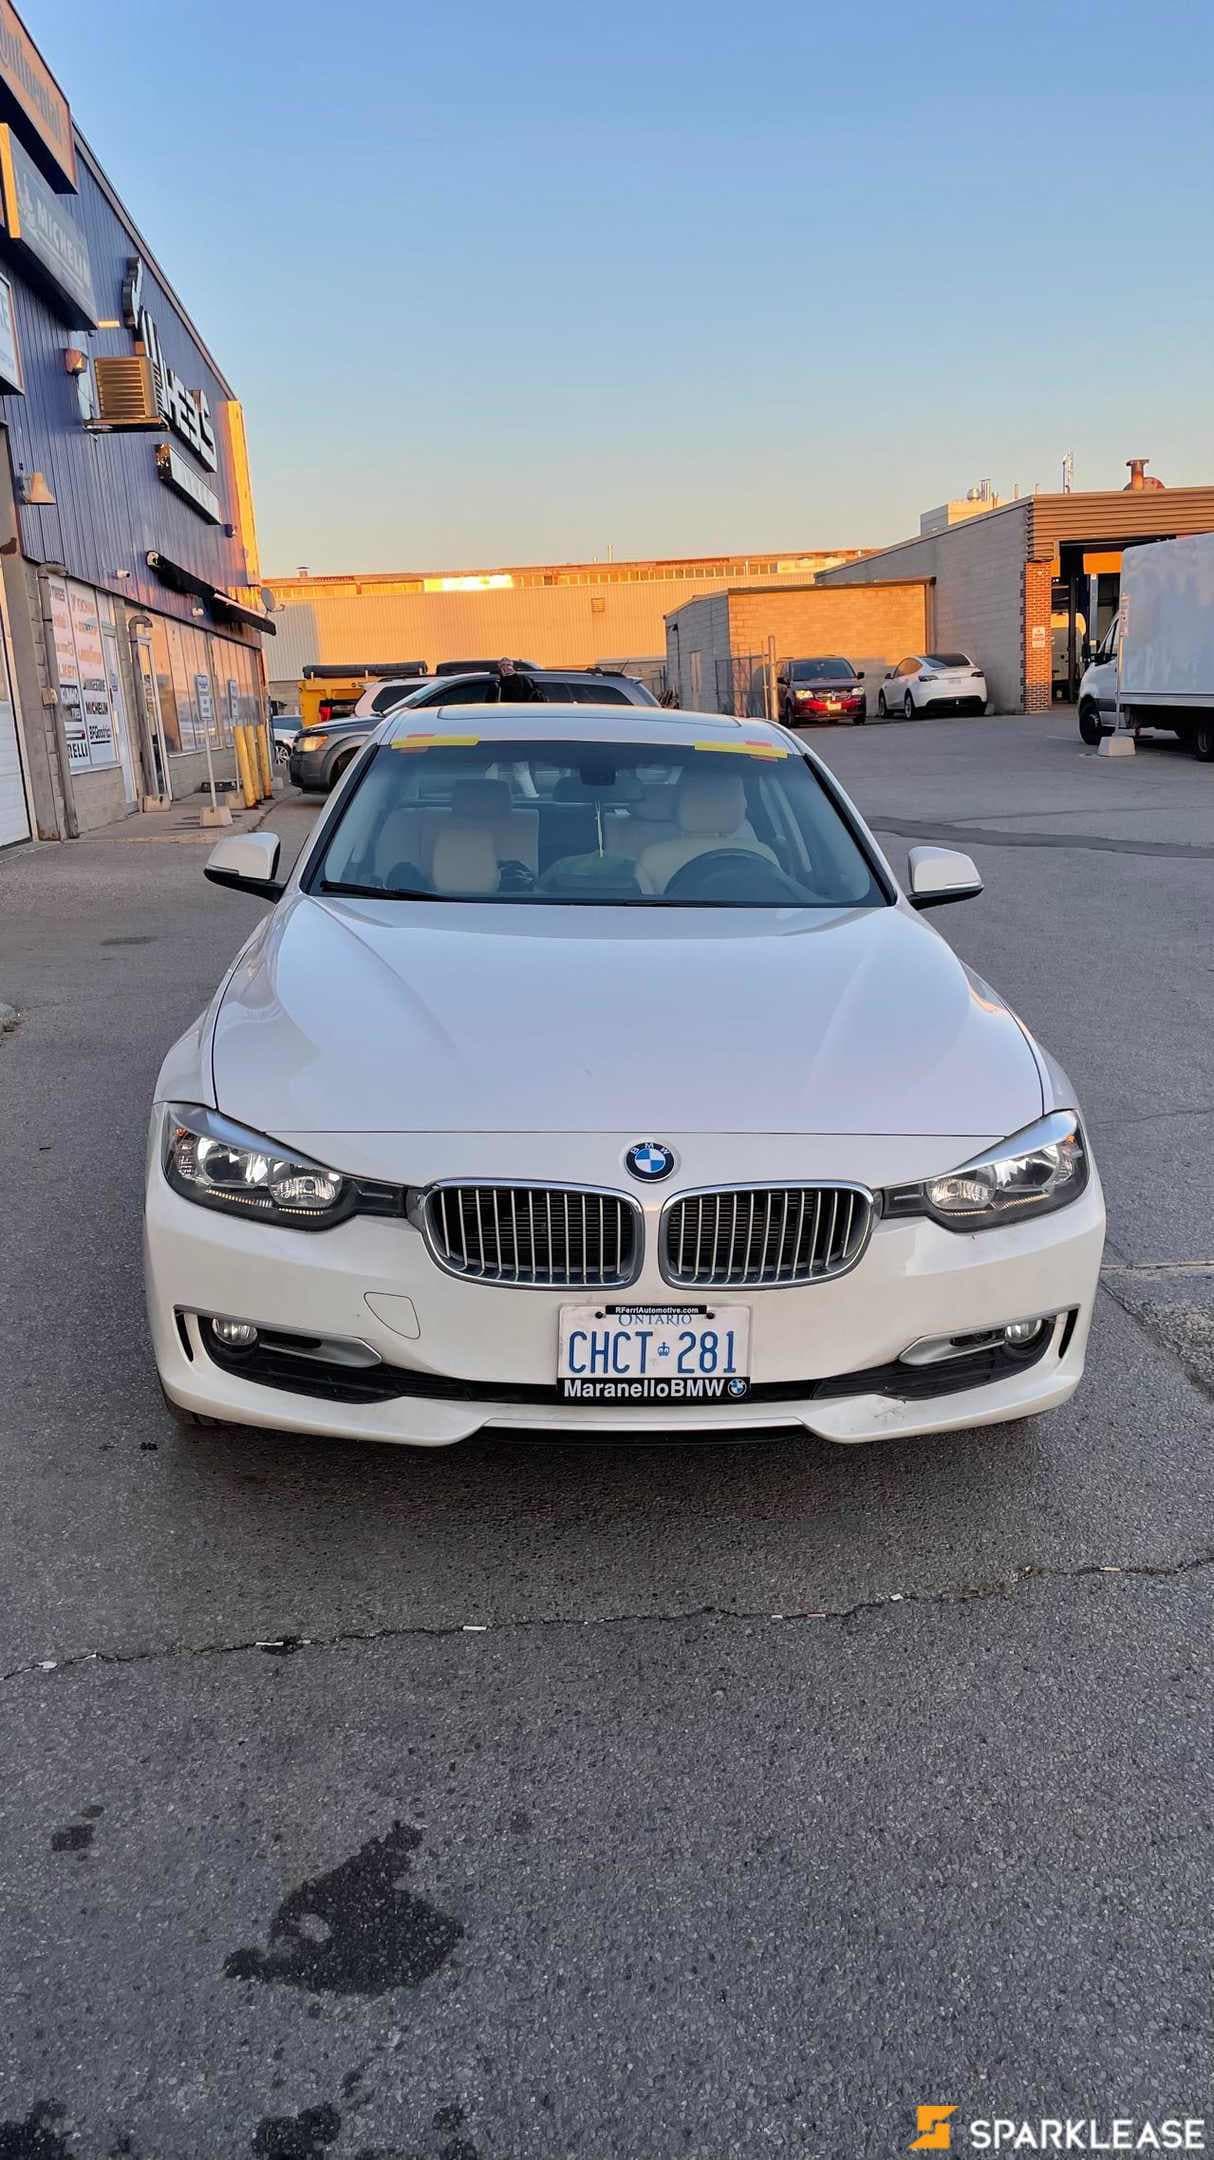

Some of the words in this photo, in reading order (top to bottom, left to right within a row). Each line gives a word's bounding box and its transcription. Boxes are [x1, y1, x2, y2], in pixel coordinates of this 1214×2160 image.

[67, 742, 88, 759] RELLI
[618, 1313, 692, 1327] ONTARIO
[568, 1330, 654, 1374] CHCT
[677, 1330, 737, 1374] 281
[563, 1378, 725, 1398] MaranelloBMW
